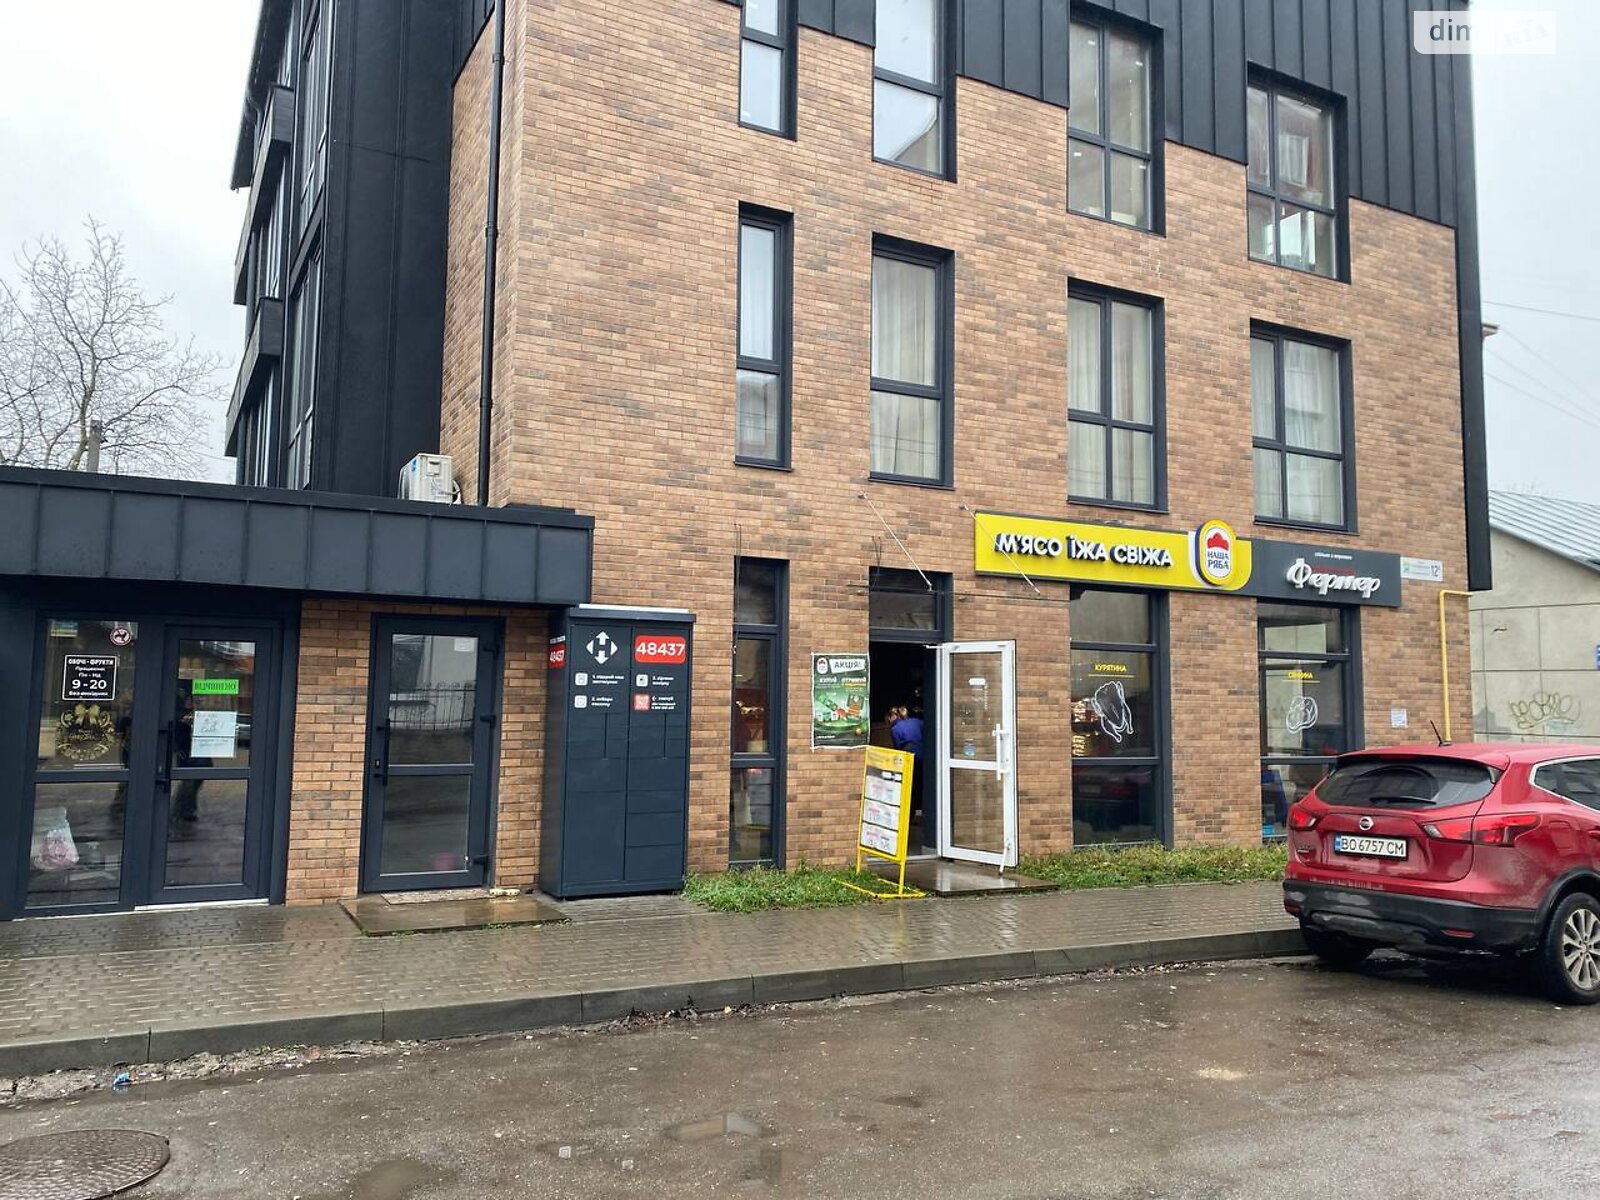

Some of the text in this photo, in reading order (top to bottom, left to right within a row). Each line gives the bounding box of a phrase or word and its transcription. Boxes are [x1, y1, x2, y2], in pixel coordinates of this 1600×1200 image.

[996, 532, 1174, 567] М'ЯСО ЇЖА СВІЖА
[1207, 551, 1229, 560] НАША
[1207, 560, 1229, 570] РЯБА
[1286, 558, 1380, 598] Фермер
[636, 642, 686, 656] 48437
[1341, 838, 1404, 855] BO 6757 CM
